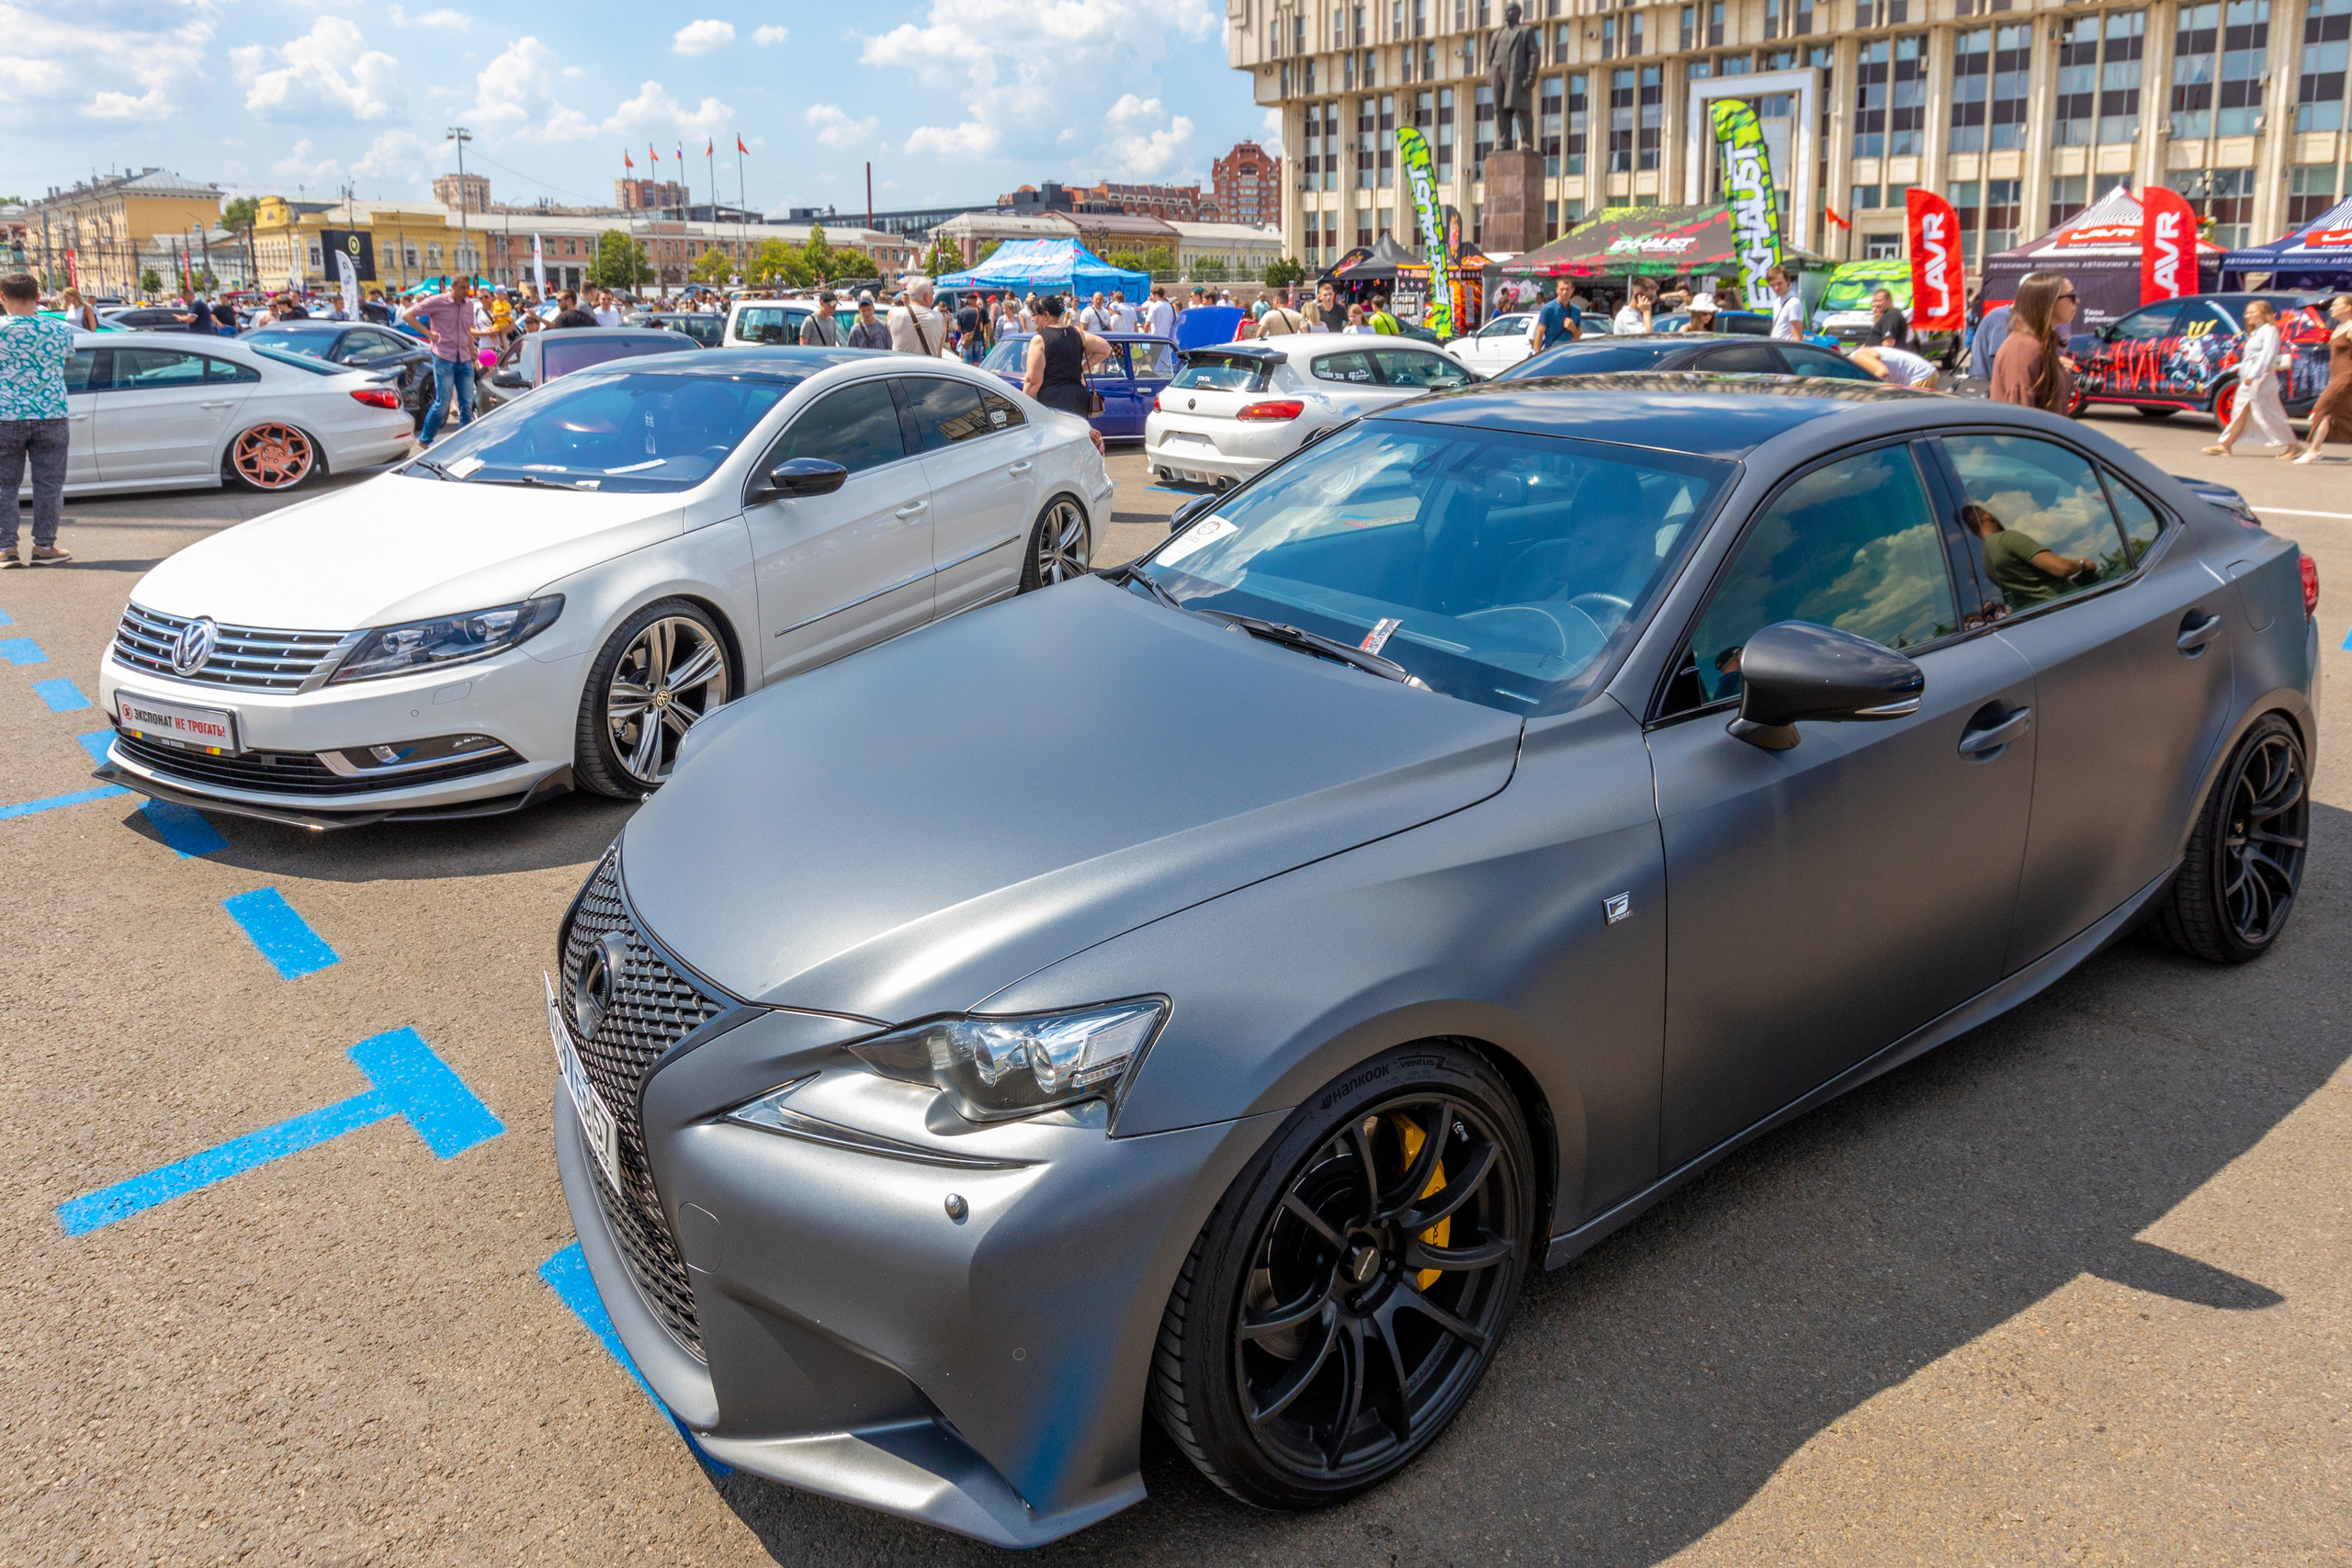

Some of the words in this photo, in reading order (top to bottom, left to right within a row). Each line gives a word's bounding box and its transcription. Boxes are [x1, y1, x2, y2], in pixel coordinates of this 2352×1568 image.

[1407, 163, 1449, 306] EXHAUST
[1610, 238, 1697, 251] EXHAUST
[2070, 228, 2136, 240] LAVR
[1922, 212, 1950, 317] LAVR
[2154, 211, 2180, 299] AVR
[133, 708, 173, 728] ЭКСПОНАТ
[175, 716, 186, 730] НЕ
[187, 719, 226, 738] ТРОГАТЬ!
[1610, 910, 1631, 924] SPORT
